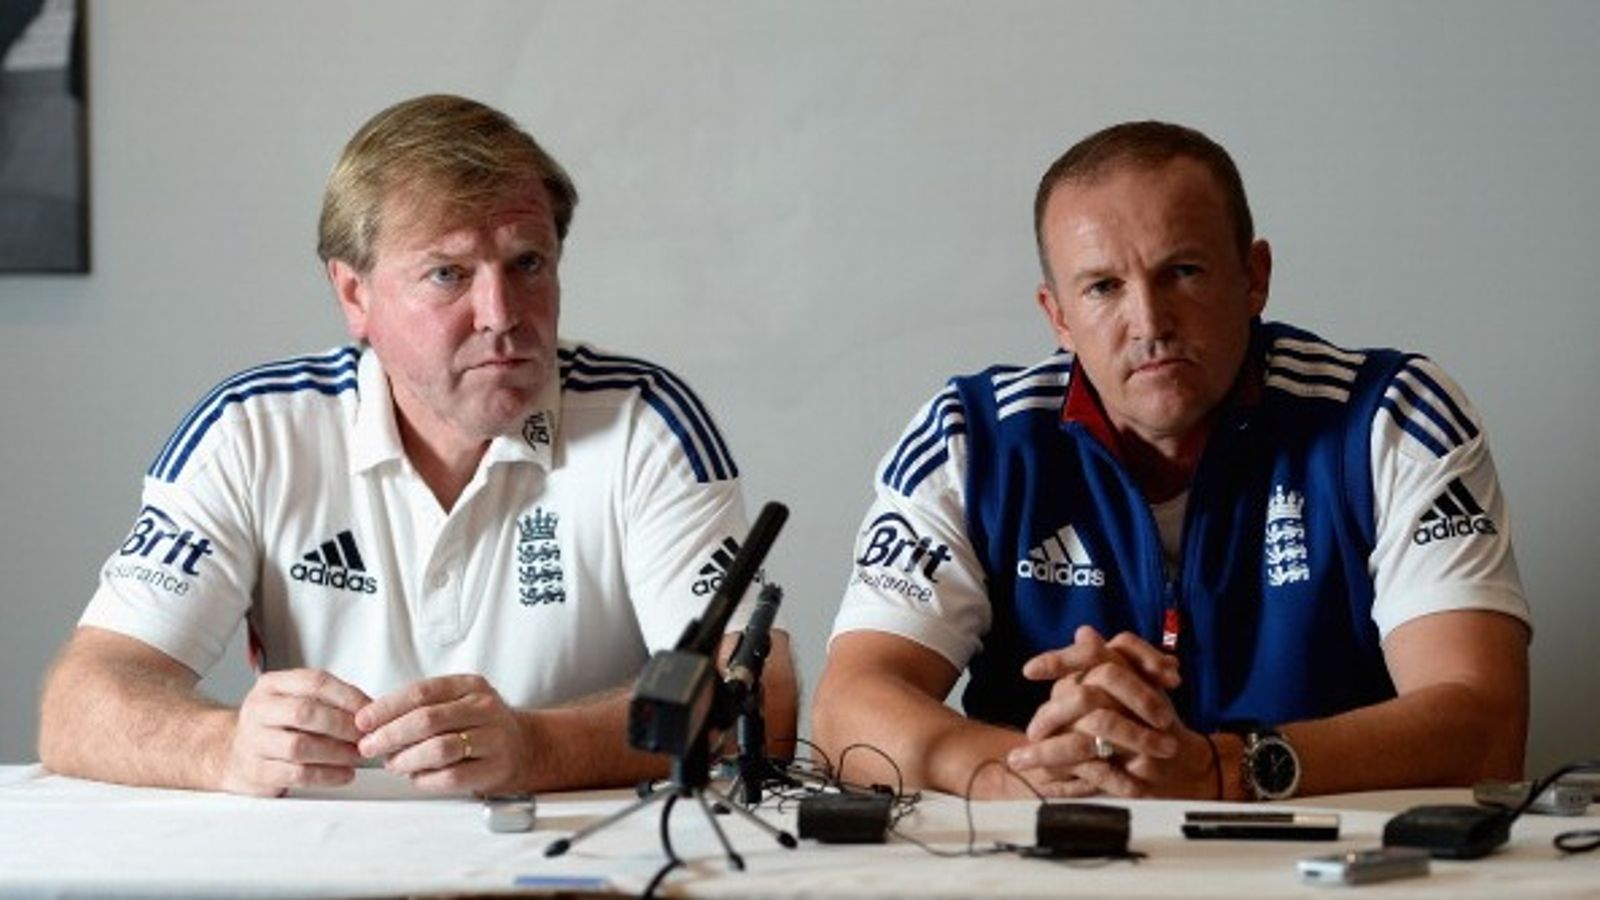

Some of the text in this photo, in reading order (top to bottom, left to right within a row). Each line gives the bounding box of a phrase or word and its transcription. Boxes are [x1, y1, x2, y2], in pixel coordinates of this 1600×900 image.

[120, 517, 212, 576] Brit
[857, 526, 951, 583] Brit
[104, 565, 189, 597] surance
[290, 562, 377, 594] adidas
[856, 572, 932, 602] surance
[1017, 559, 1105, 586] adidas
